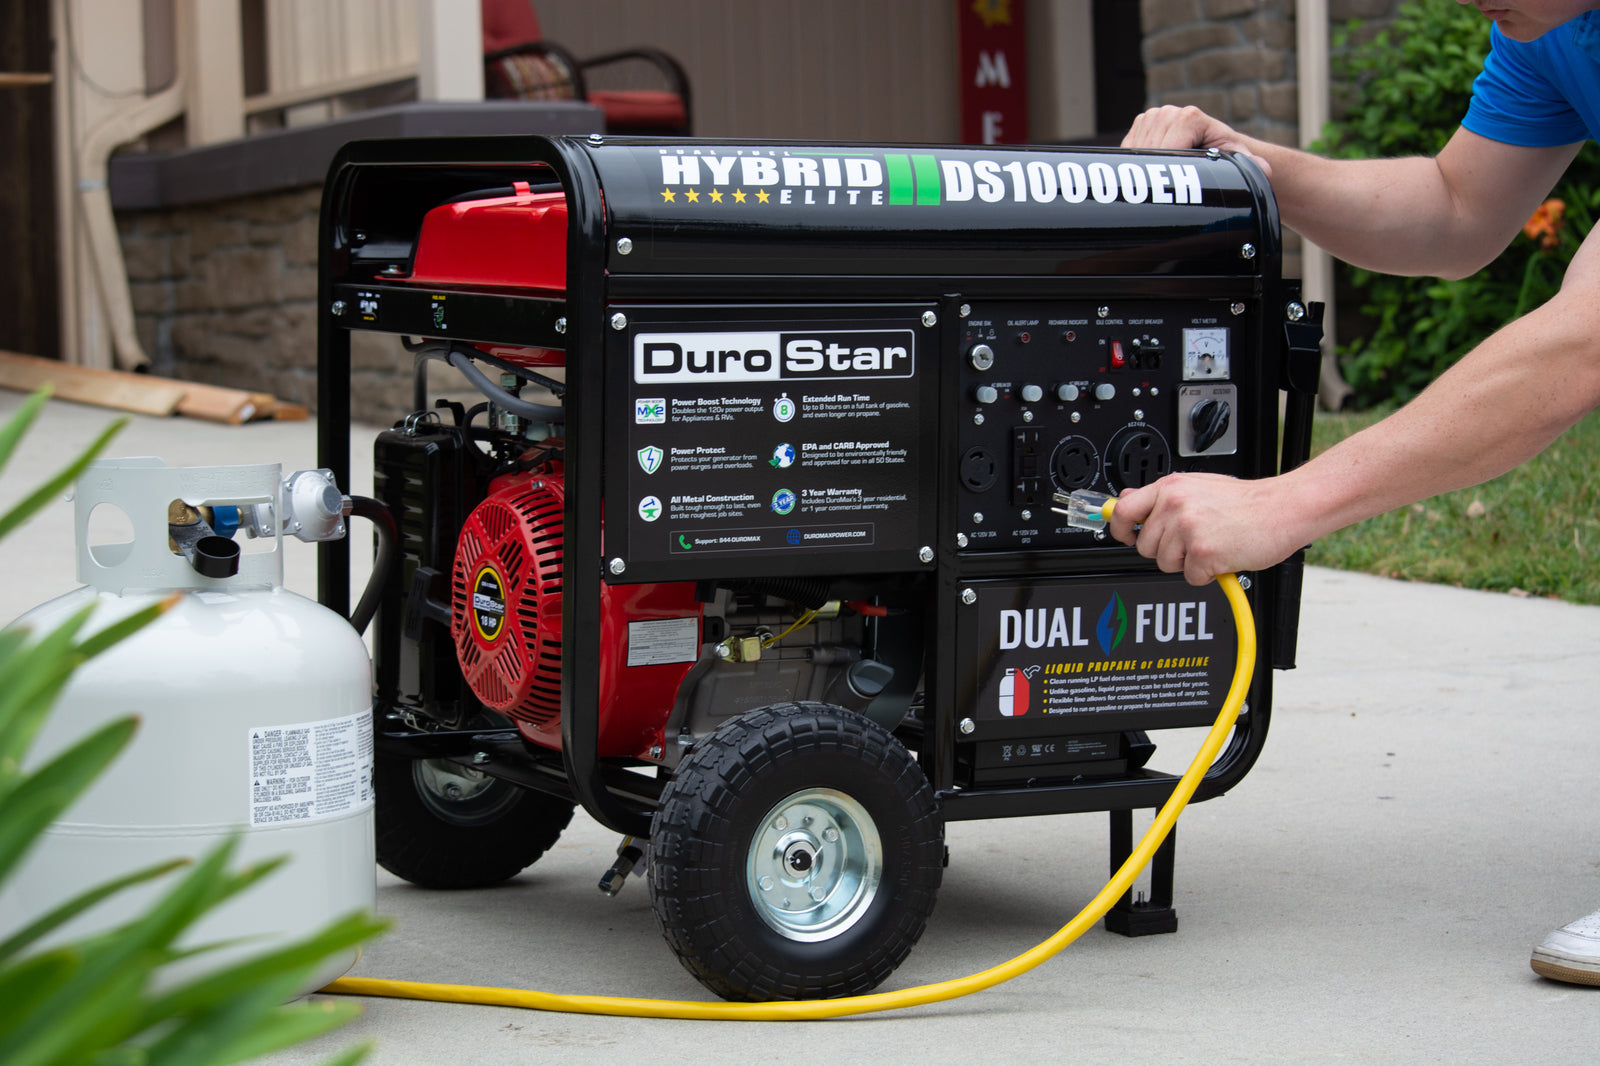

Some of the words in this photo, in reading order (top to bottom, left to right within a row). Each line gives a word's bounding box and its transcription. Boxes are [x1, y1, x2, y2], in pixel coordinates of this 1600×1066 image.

[660, 155, 883, 187] HYBRID
[940, 159, 1203, 204] DS10000EH
[780, 189, 883, 205] ELITE
[672, 398, 696, 406] Power
[698, 398, 720, 406] Boost
[721, 397, 762, 406] Technology
[802, 395, 836, 403] Extended
[837, 394, 852, 402] Run
[637, 404, 664, 418] MX2
[780, 405, 788, 415] 8
[802, 404, 811, 412] Up
[682, 415, 714, 423] Appliances
[829, 411, 847, 419] longer
[856, 440, 890, 450] Approved
[712, 455, 742, 463] generator
[802, 452, 828, 460] Designed
[826, 488, 862, 496] Warranty
[706, 494, 754, 502] Construction
[1000, 606, 1089, 650] DUAL
[1136, 602, 1214, 644] FUEL
[1044, 662, 1084, 675] LIQUID
[1087, 660, 1137, 672] PROPANE
[1140, 660, 1153, 670] or
[1157, 656, 1210, 668] GASOLINE
[1048, 706, 1072, 714] Designed
[1096, 704, 1116, 712] gasoline
